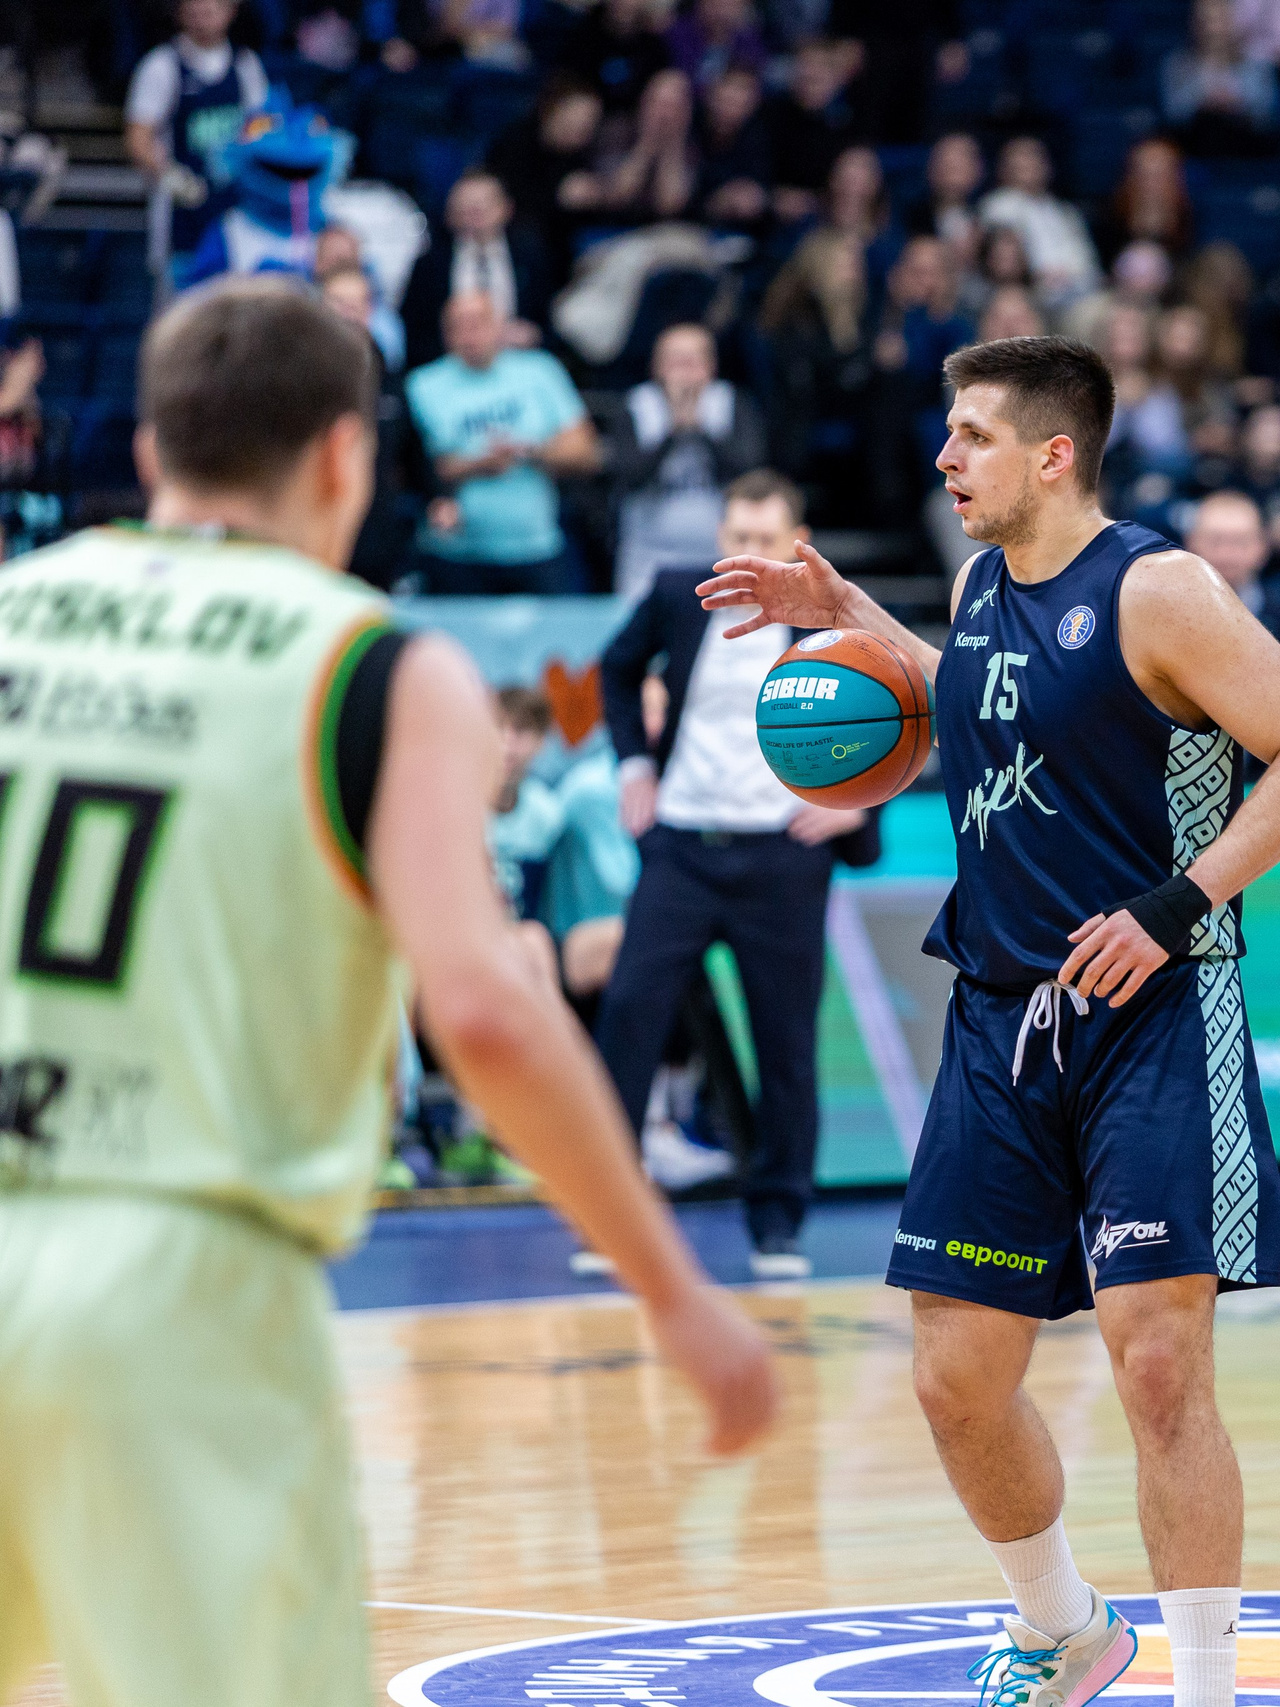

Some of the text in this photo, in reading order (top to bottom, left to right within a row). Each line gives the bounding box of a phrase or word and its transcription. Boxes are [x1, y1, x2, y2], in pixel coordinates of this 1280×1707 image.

[954, 631, 990, 651] Kempa
[761, 677, 840, 703] SIBUR
[979, 652, 1029, 721] 15
[800, 702, 814, 710] 2.0
[782, 741, 795, 749] LIFE
[796, 741, 804, 749] OF
[805, 736, 834, 748] PLASTIC
[946, 1239, 1048, 1275] евроопт
[524, 1634, 810, 1707] ДИНАЯ
